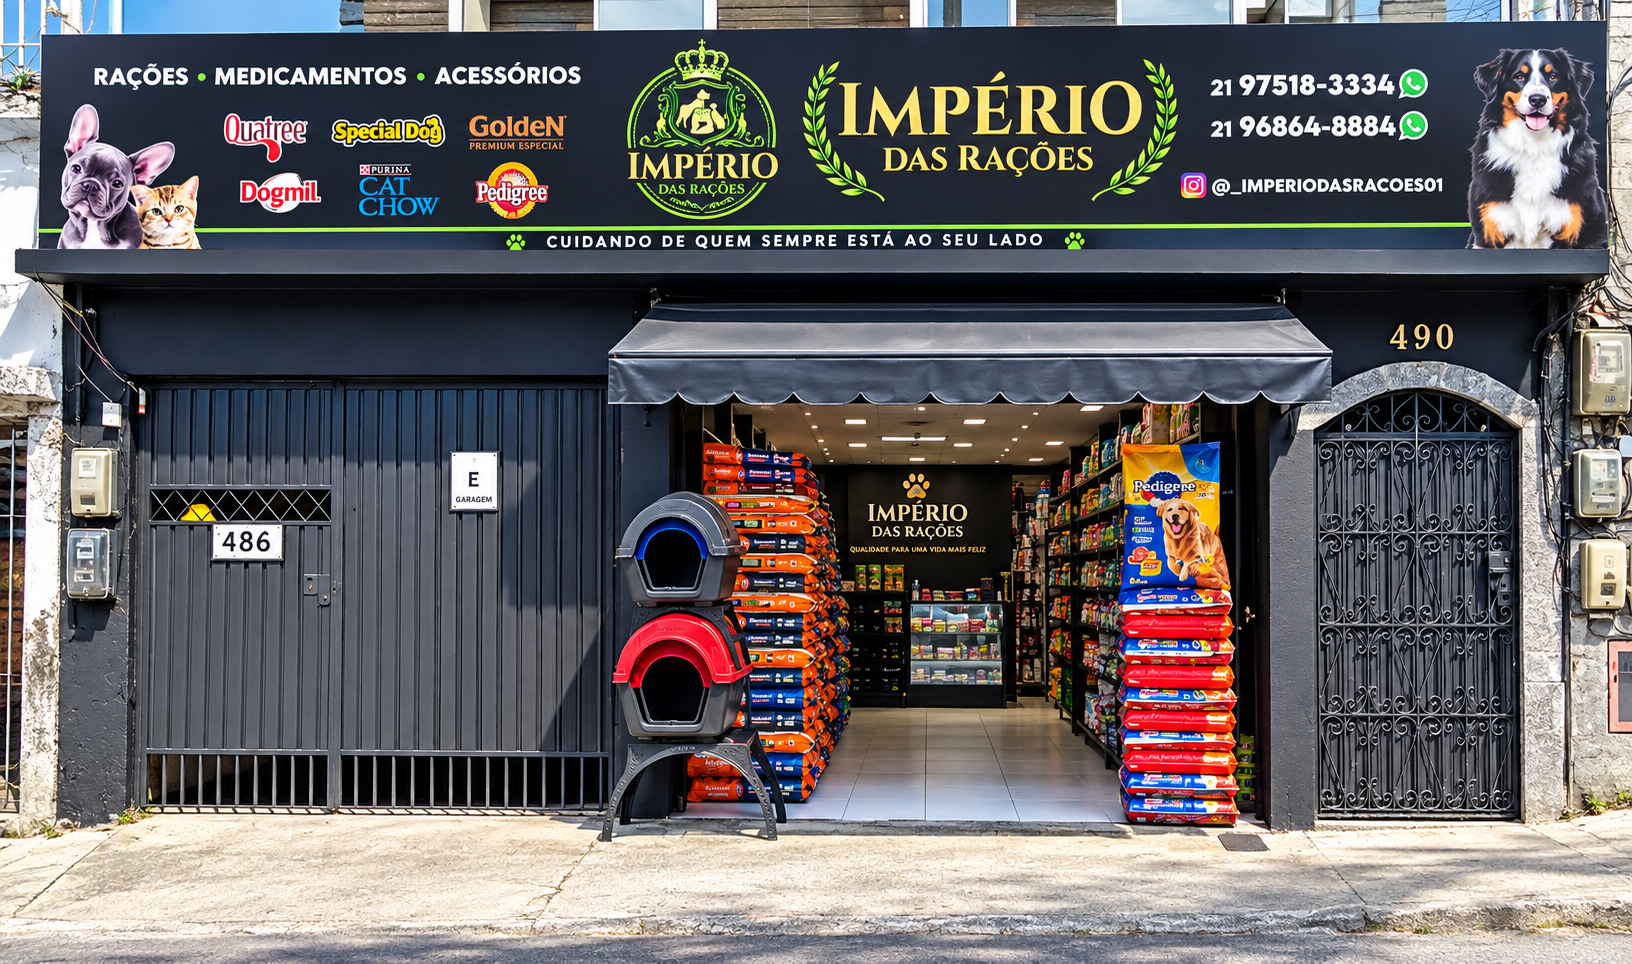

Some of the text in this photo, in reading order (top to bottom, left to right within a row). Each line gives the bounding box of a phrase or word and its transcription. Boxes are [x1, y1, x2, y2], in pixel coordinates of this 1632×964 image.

[93, 61, 582, 91] RAÇÕES MEDICAMENTOS ACESSÓRIOS
[1210, 73, 1396, 97] 21 97518-3334
[838, 71, 1143, 137] IMPÉRIO
[333, 116, 444, 146] Special Dog
[1210, 115, 1397, 138] 21 96864-8884
[225, 114, 306, 162] Quatree
[469, 141, 564, 151] PREMIUM ESPECIAL
[371, 166, 410, 174] PURINA
[627, 146, 779, 180] IMPÉRIO
[882, 141, 1094, 178] DAS RAÇÕES
[358, 176, 411, 196] CAT
[477, 181, 548, 206] Pedigree
[658, 181, 745, 198] DAS RAÇÕES
[1211, 177, 1443, 198] @_IMPERIODASRACOES01
[358, 197, 440, 217] CHOW
[545, 230, 1043, 249] CUIDANDO DE QUEM SEMPRE ESTÁ AO SEU LADO
[1389, 323, 1454, 350] 490
[468, 471, 479, 487] E
[867, 499, 968, 522] IMPÉRIO
[222, 530, 271, 552] 486
[871, 523, 964, 540] DAS RAÇÕES
[849, 545, 890, 554] QUALIDADE
